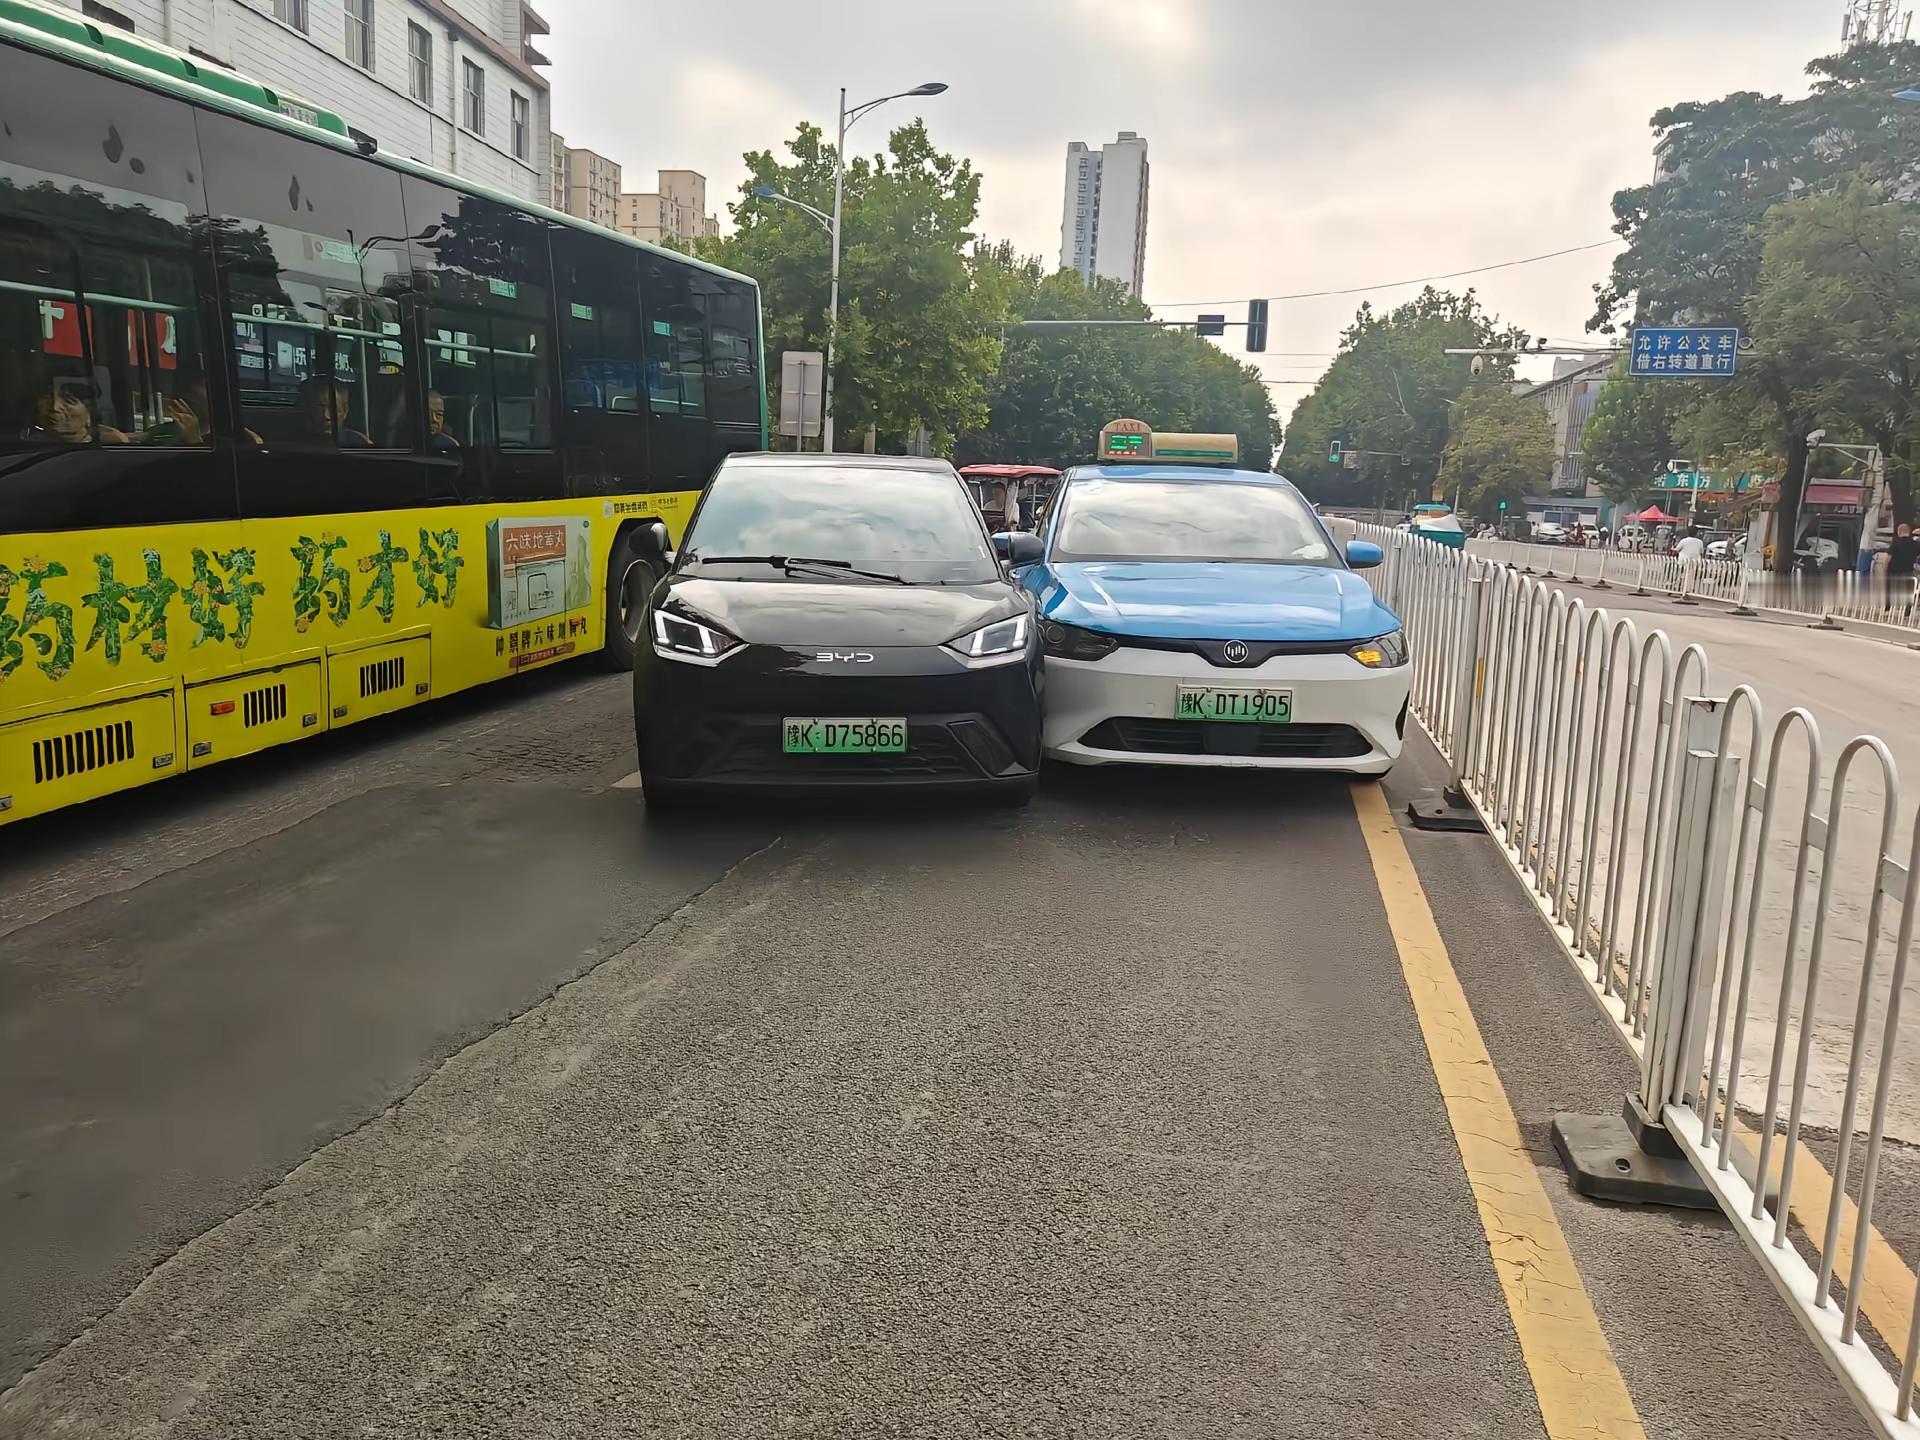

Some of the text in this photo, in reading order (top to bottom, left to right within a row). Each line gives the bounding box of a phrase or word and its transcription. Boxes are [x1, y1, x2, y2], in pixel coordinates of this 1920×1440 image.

[1637, 335, 1733, 351] 允许公交车
[1635, 353, 1731, 370] 借右转道直行
[1115, 422, 1141, 432] TAXI
[289, 526, 464, 634] 药才好
[815, 652, 874, 663] BYD
